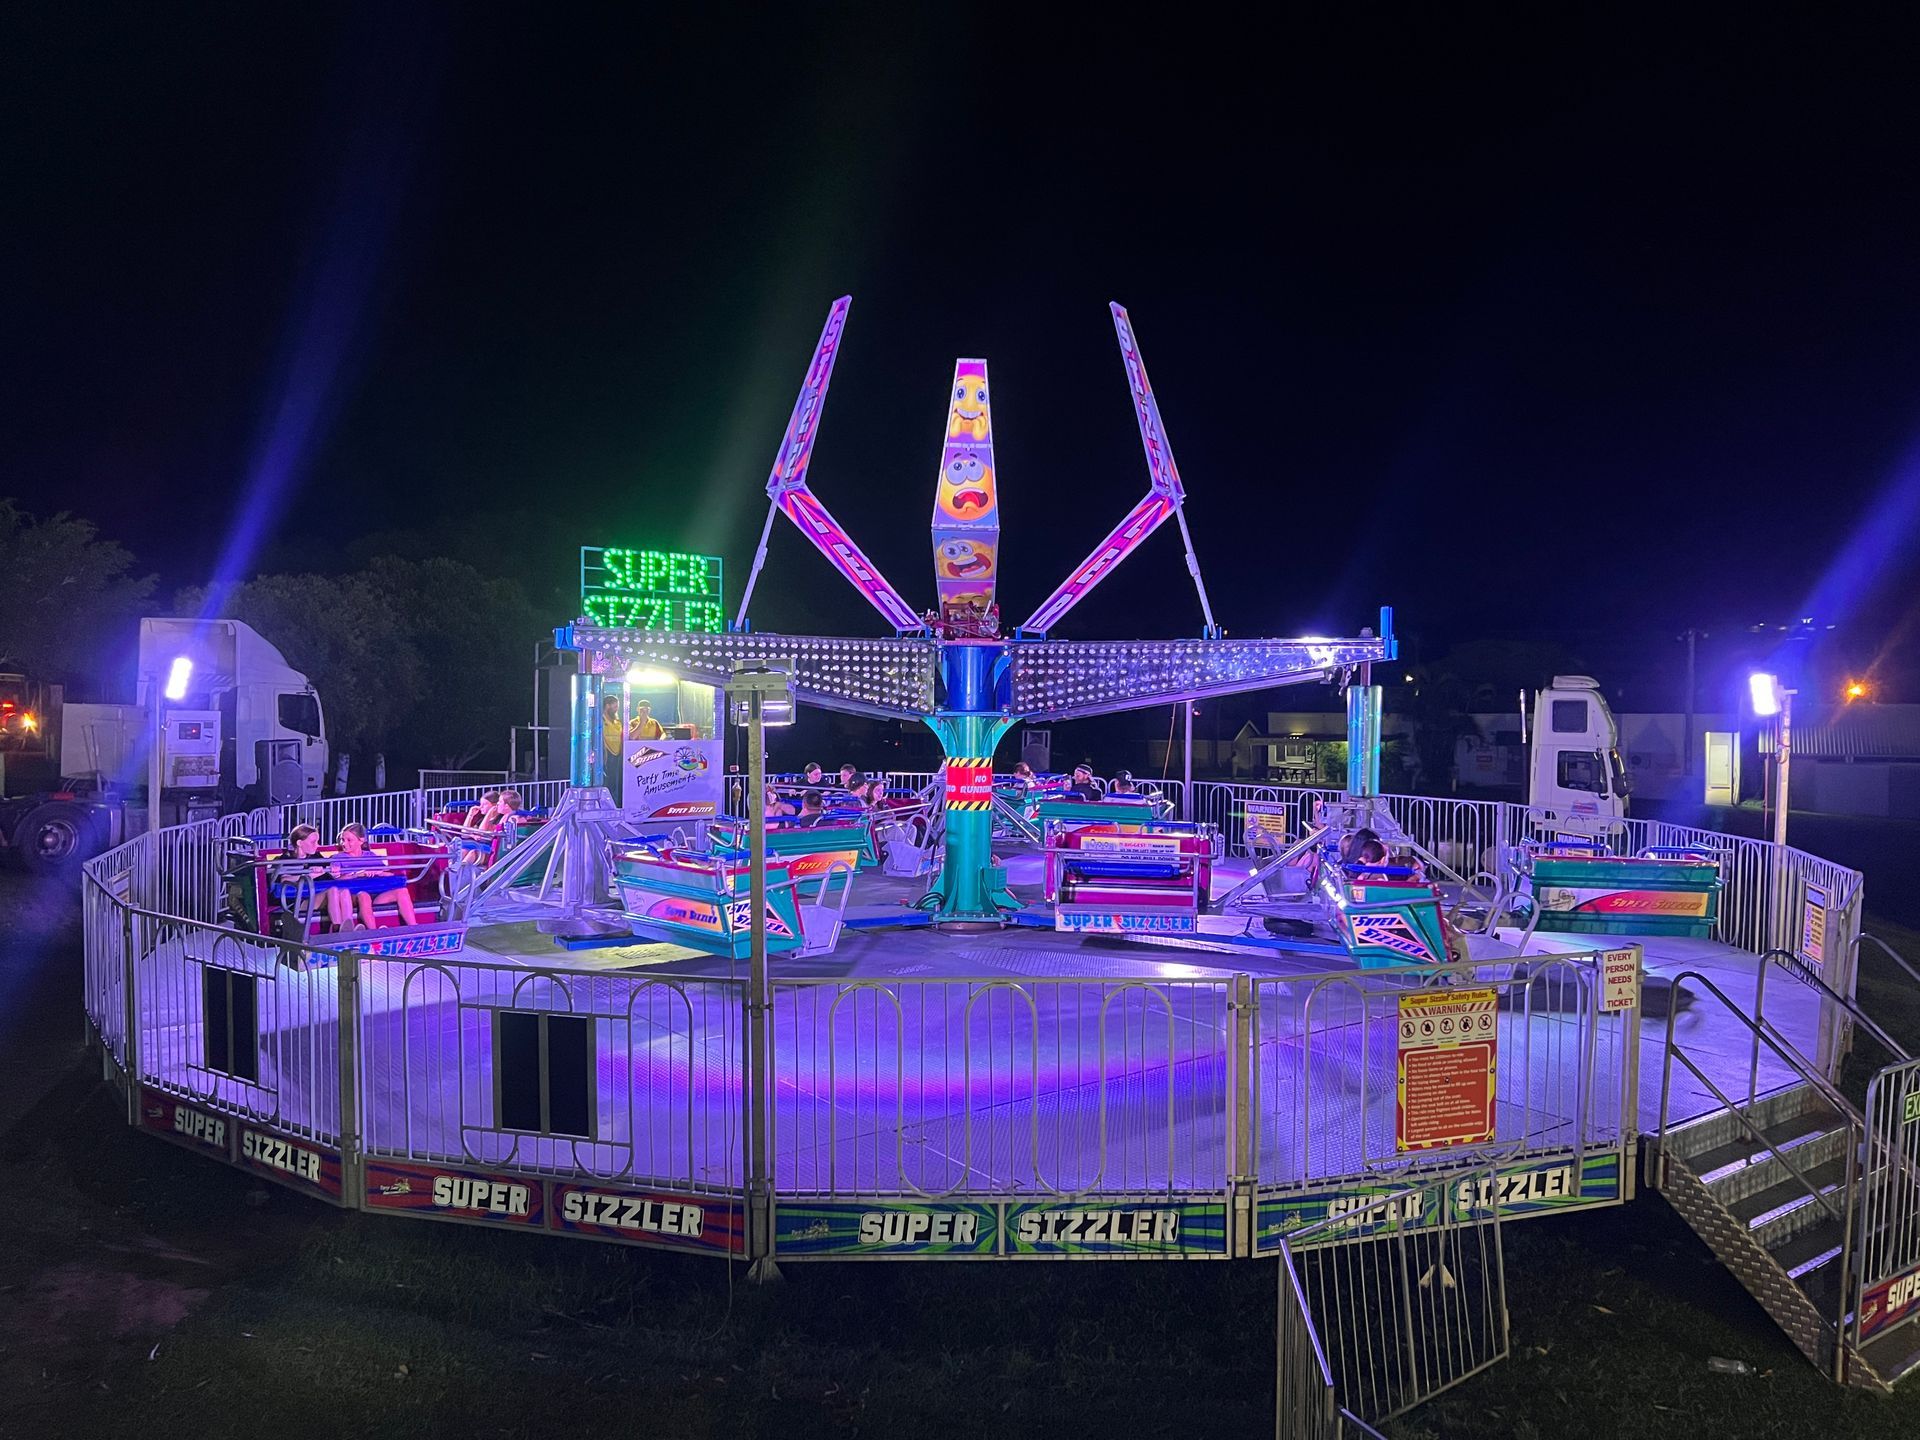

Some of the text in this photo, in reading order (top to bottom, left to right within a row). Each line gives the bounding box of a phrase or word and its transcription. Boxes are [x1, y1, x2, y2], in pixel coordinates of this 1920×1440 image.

[603, 548, 709, 595] SUPER
[637, 772, 659, 787] Party
[975, 775, 987, 783] NO
[1248, 804, 1283, 814] WARNING
[1062, 914, 1192, 930] SUPER SIZZLER
[1355, 916, 1398, 926] SUPER
[380, 932, 458, 956] SIZZLER
[1360, 928, 1425, 954] SIZZLER
[1608, 952, 1632, 962] EVERY
[1606, 964, 1634, 974] PERSON
[1608, 976, 1632, 984] NEEDS
[1606, 998, 1634, 1008] TICKET
[1428, 1004, 1468, 1016] WARNING
[174, 1106, 321, 1183] SUPER SIZZLER
[432, 1176, 704, 1237] SUPER SIZZLER
[858, 1210, 1180, 1244] SUPER SIZZLER
